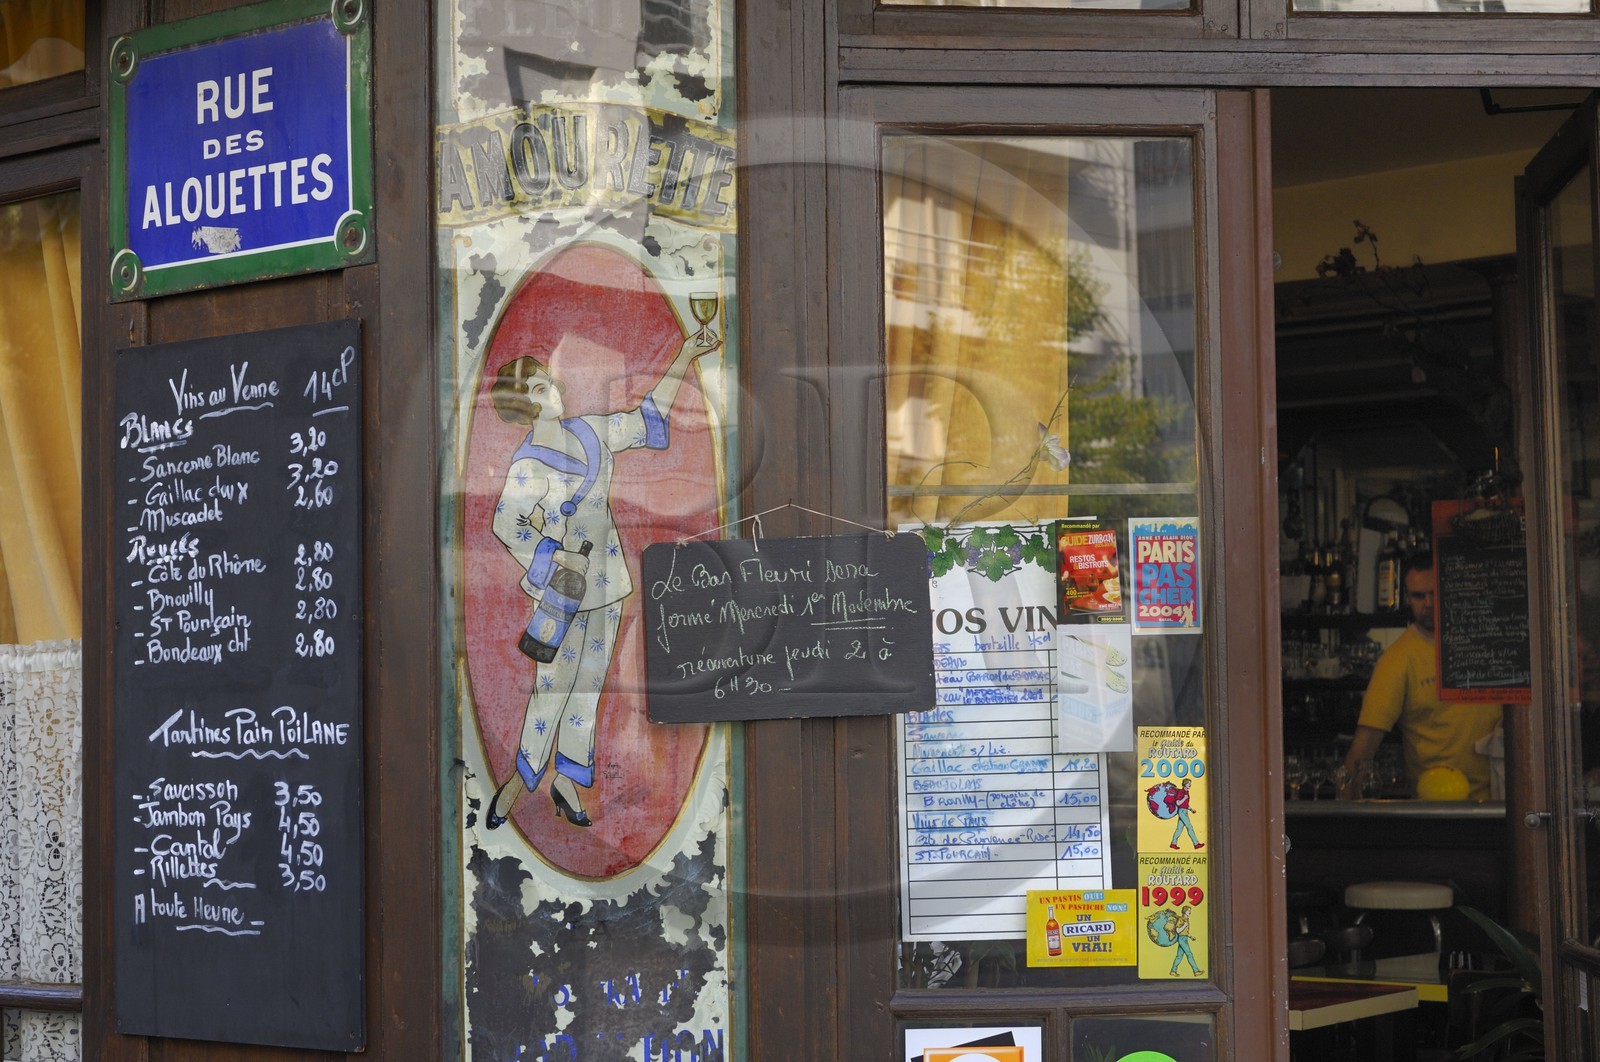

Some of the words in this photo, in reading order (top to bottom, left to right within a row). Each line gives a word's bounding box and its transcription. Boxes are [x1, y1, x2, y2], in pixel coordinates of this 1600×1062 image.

[197, 67, 273, 124] RUE
[203, 130, 264, 160] DES
[438, 114, 736, 217] AMOURETTE
[142, 153, 334, 229] ALOUETTES
[169, 368, 204, 415] Vins
[208, 387, 226, 406] au
[212, 444, 260, 467] Blanc
[290, 426, 326, 456] 3,20
[145, 478, 202, 506] Gaillac
[286, 457, 339, 490] 3,20
[140, 498, 223, 533] Muscadet
[294, 480, 334, 510] 2,60
[294, 541, 334, 566] 2,80
[1061, 535, 1088, 546] GUIDE
[1138, 541, 1195, 563] PARIS
[188, 558, 206, 581] du
[208, 550, 266, 579] Rhône
[295, 566, 332, 592] 2,80
[1070, 554, 1096, 562] RESTOS
[651, 549, 685, 600] Le
[740, 559, 812, 583] Fleuri
[1142, 564, 1192, 588] PAS
[1140, 588, 1194, 604] CHER
[295, 597, 337, 624] 2,80
[1139, 605, 1183, 617] 2004
[295, 629, 334, 658] 2,80
[786, 640, 830, 681] jeudi
[878, 637, 895, 660] à
[148, 708, 230, 747] Tartines
[225, 708, 272, 744] Pain
[1140, 729, 1190, 738] RECOMMANDÉ
[1148, 747, 1198, 759] ROUTARD
[1141, 758, 1205, 778] 2000
[148, 778, 238, 801] Saucisson
[274, 781, 322, 808] 3,50
[138, 802, 206, 828] Jambon
[210, 800, 252, 845] Pays
[278, 806, 320, 839] 4,50
[150, 828, 227, 860] Cantal
[280, 832, 324, 867] 4,50
[1140, 856, 1190, 864] RECOMMANDÉ
[150, 856, 218, 888] Rillettes
[278, 864, 326, 892] 3,50
[1148, 874, 1198, 886] ROUTARD
[134, 893, 146, 925] A
[150, 888, 188, 918] toute
[1053, 894, 1081, 902] PASTIS
[1107, 904, 1127, 912] NON!
[1142, 886, 1204, 906] 1999
[1066, 924, 1112, 934] RICARD
[1076, 914, 1092, 922] UN
[1072, 942, 1112, 952] VRAI!
